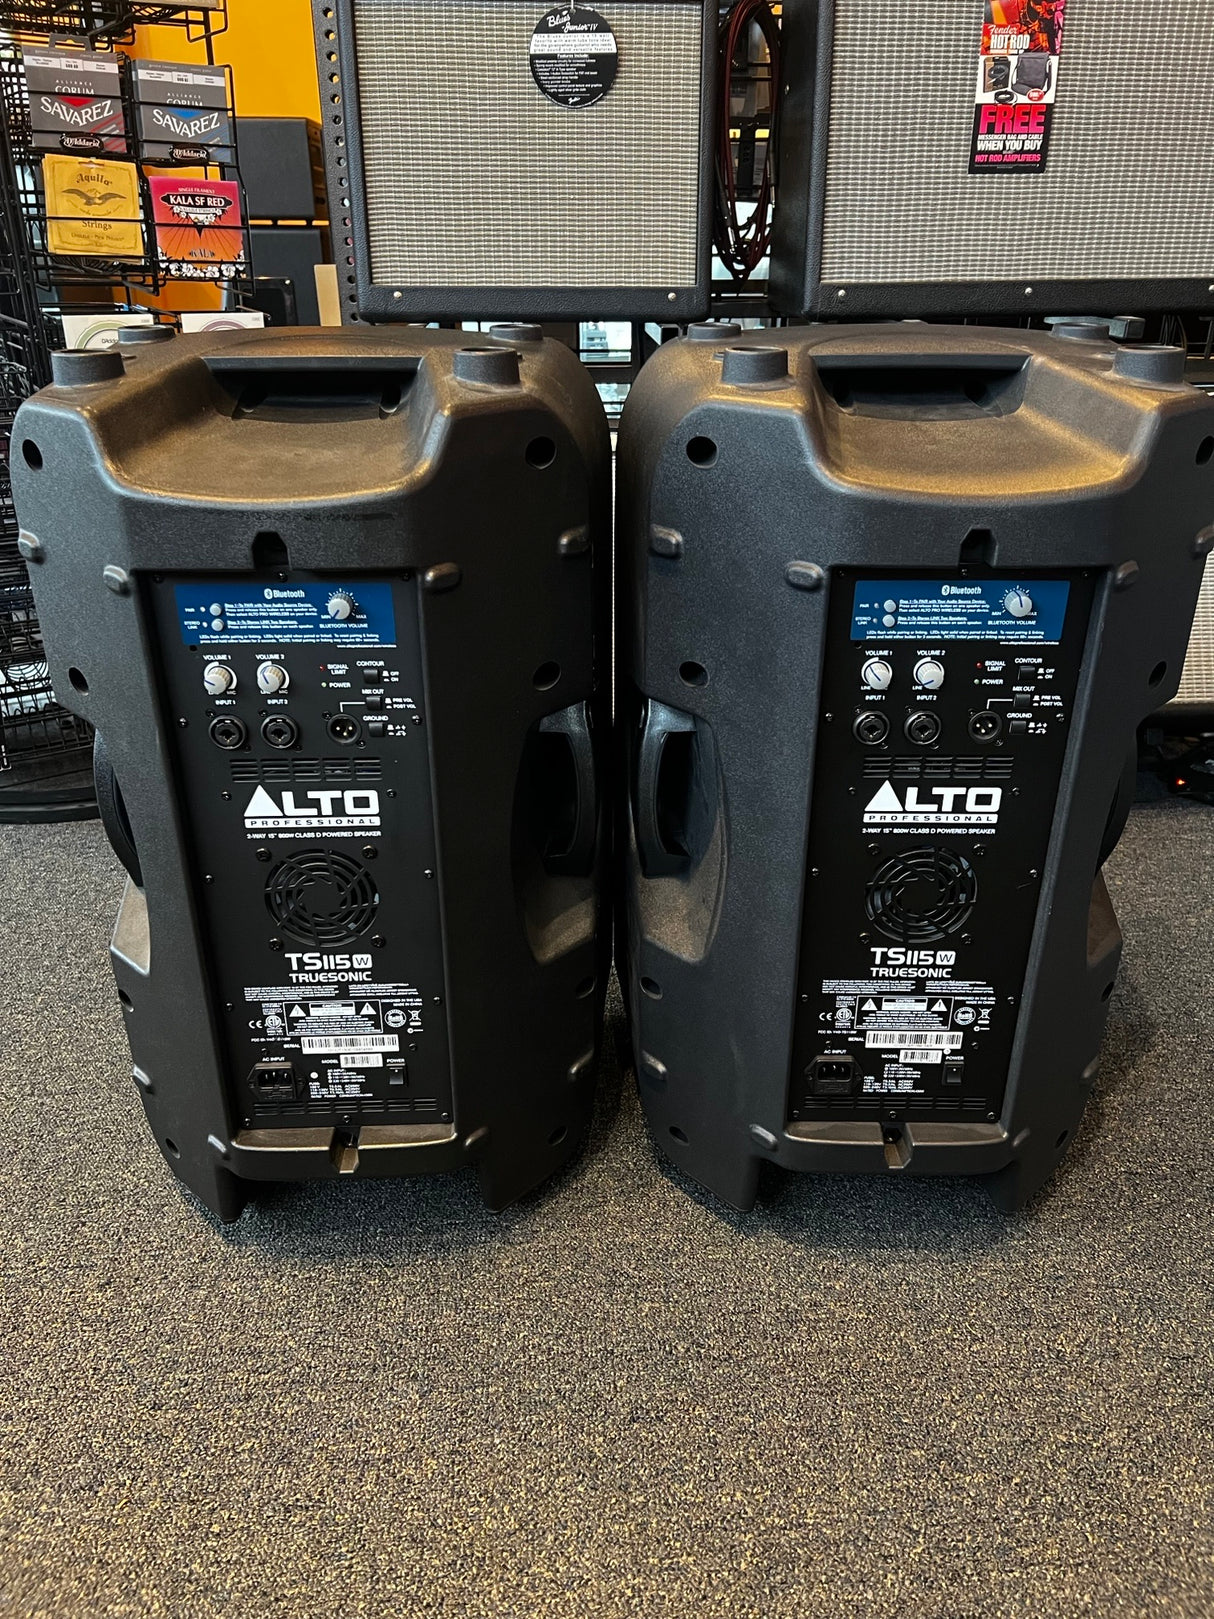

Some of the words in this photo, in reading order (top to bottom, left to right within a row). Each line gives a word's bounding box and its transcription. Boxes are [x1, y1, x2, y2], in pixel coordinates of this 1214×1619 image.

[546, 13, 571, 27] Blues
[562, 22, 588, 33] Junior
[988, 25, 1017, 35] Fender
[990, 34, 1010, 49] HOT
[1010, 34, 1030, 49] ROD
[55, 86, 95, 95] CORUM
[40, 96, 114, 126] SAVAREZ
[152, 109, 220, 138] SAVAREZ
[978, 104, 1047, 134] FREE
[977, 140, 1003, 151] WHEN
[1005, 140, 1023, 151] YOU
[1024, 140, 1043, 151] BUY
[974, 155, 989, 163] HOT
[989, 154, 1003, 162] ROD
[1003, 154, 1042, 162] AMPLIFIERS
[170, 195, 194, 205] KALA
[195, 196, 206, 206] SF
[207, 197, 225, 206] RED
[82, 220, 113, 231] Strings
[273, 590, 305, 598] Bluetooth
[950, 586, 982, 595] Bluetooth
[243, 784, 380, 818] ALTO
[864, 780, 1002, 812] ALTO
[251, 818, 376, 827] PROFESSIONAL
[289, 972, 372, 983] TRUESONIC
[870, 968, 953, 978] TRUESONIC
[819, 1012, 833, 1021] CE
[248, 1020, 263, 1029] CE
